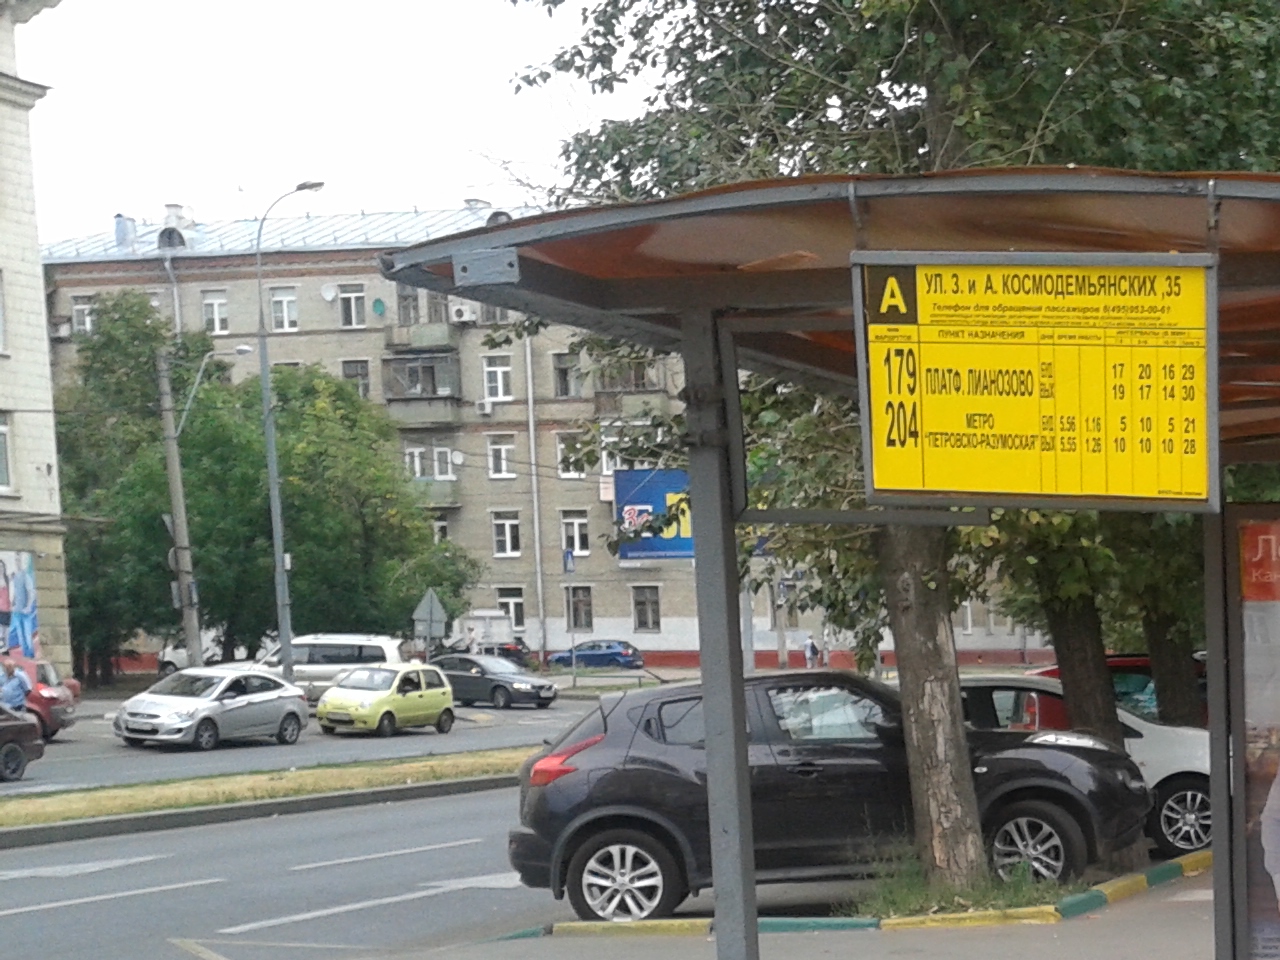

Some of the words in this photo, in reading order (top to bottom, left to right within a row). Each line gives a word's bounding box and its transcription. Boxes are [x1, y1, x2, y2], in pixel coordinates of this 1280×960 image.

[924, 273, 947, 295] УЛ.
[968, 278, 977, 295] и
[984, 273, 998, 295] А.
[1002, 273, 1157, 299] КОСМОДЕМЬЯНСКИХ
[880, 276, 908, 315] А
[938, 329, 965, 339] ПУНКТ
[968, 330, 1025, 340] НАЗНАЧЕНИЯ
[883, 347, 917, 396] 179
[1112, 363, 1125, 379] 17
[1138, 363, 1151, 380] 20
[1162, 364, 1175, 380] 16
[1182, 364, 1195, 381] 29
[925, 367, 965, 396] ПЛАТФ.
[967, 368, 1034, 397] ЛИАНОЗОВО
[1112, 383, 1125, 400] 19
[1139, 384, 1152, 400] 17
[1163, 384, 1175, 401] 14
[1182, 385, 1195, 401] 30
[885, 400, 919, 448] 204
[966, 413, 995, 430] МЕТРО
[1120, 416, 1127, 432] 5
[1140, 416, 1152, 433] 10
[1168, 417, 1175, 433] 5
[1184, 417, 1196, 434] 21
[1114, 437, 1126, 453] 10
[1139, 437, 1152, 454] 10
[1162, 438, 1174, 454] 10
[1184, 438, 1196, 455] 28
